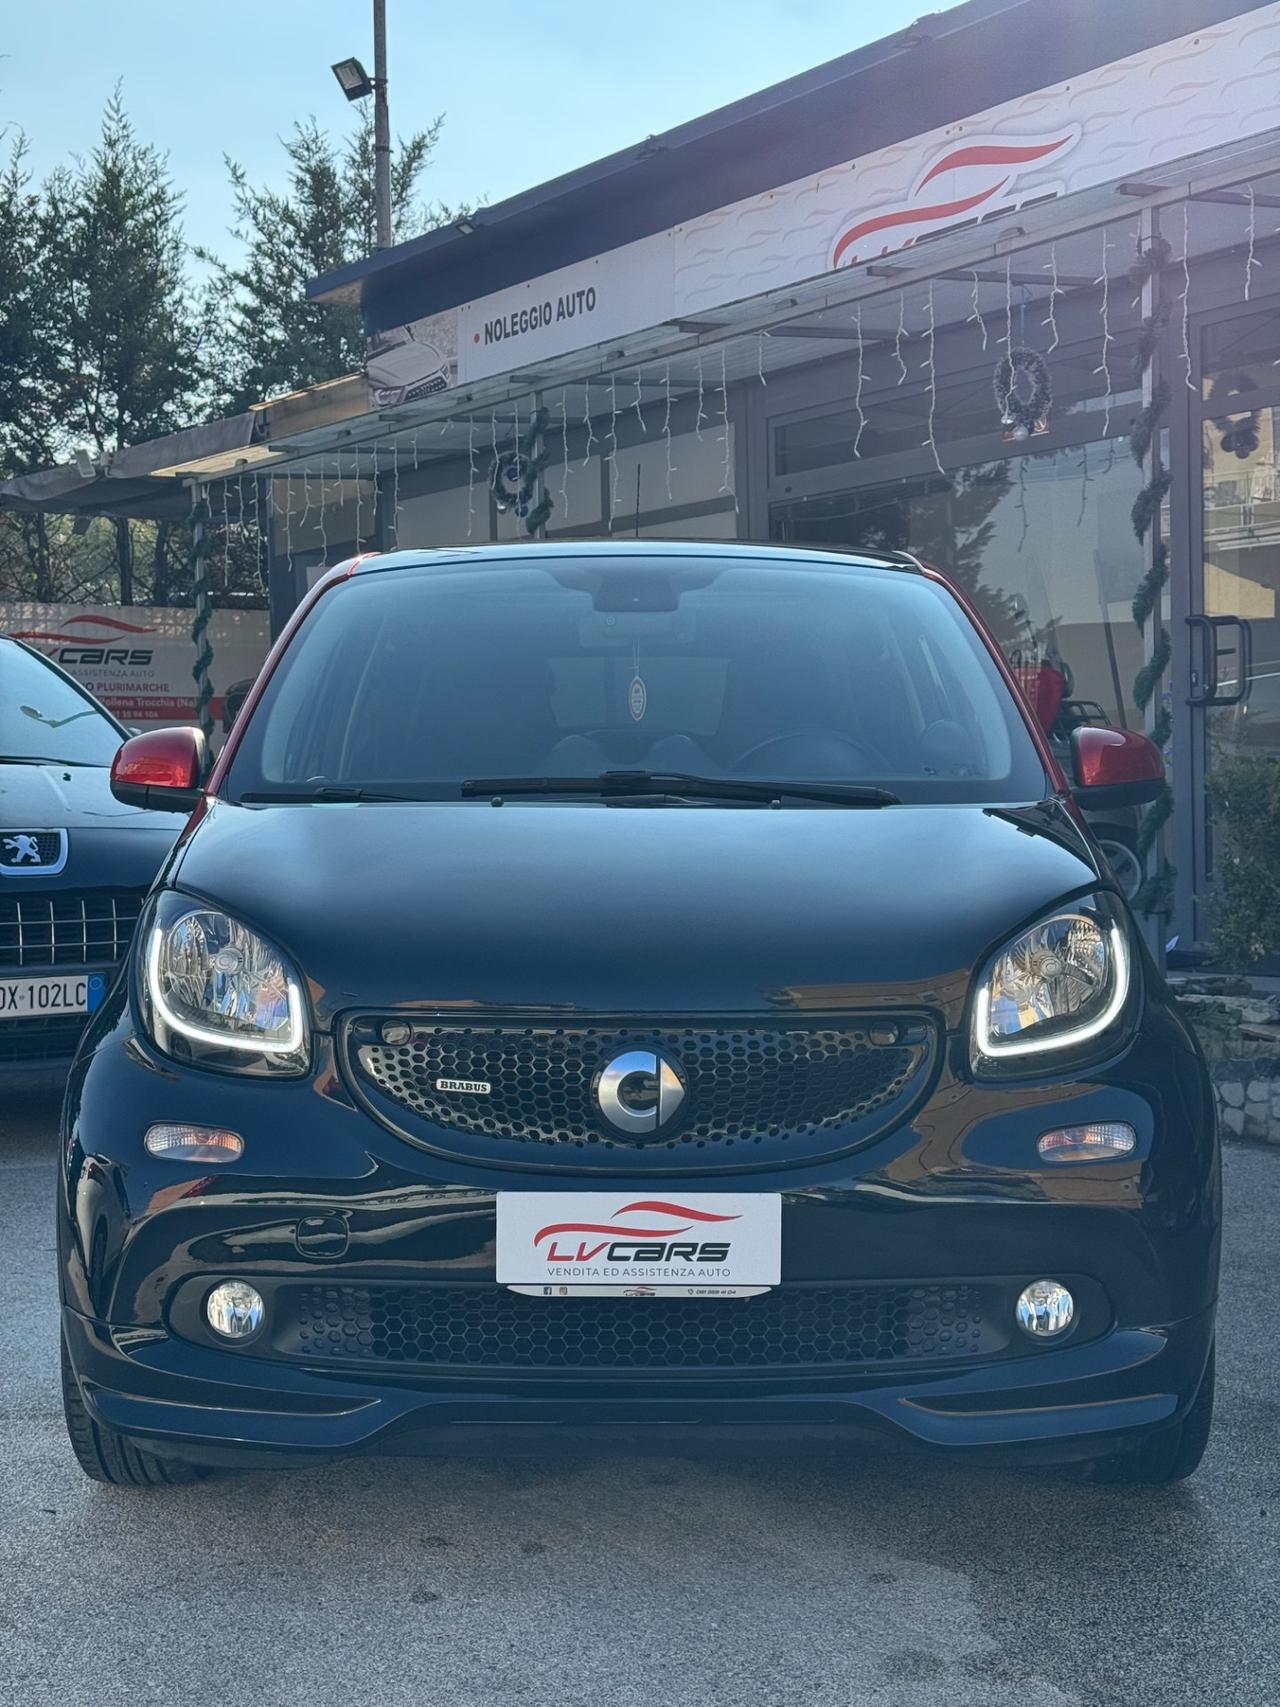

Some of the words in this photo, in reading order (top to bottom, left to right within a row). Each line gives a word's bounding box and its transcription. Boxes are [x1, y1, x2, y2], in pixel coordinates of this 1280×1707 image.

[484, 302, 551, 345] NOLEGGIO
[556, 287, 596, 322] AUTO
[130, 669, 154, 678] AUTO
[97, 682, 169, 692] PLURIMARCHE
[28, 982, 86, 1008] 102LC
[440, 1081, 487, 1092] BRABUS
[547, 1267, 600, 1277] VENDITA
[603, 1268, 619, 1277] ED
[622, 1268, 695, 1277] ASSISTENZA
[698, 1268, 731, 1277] AUTO
